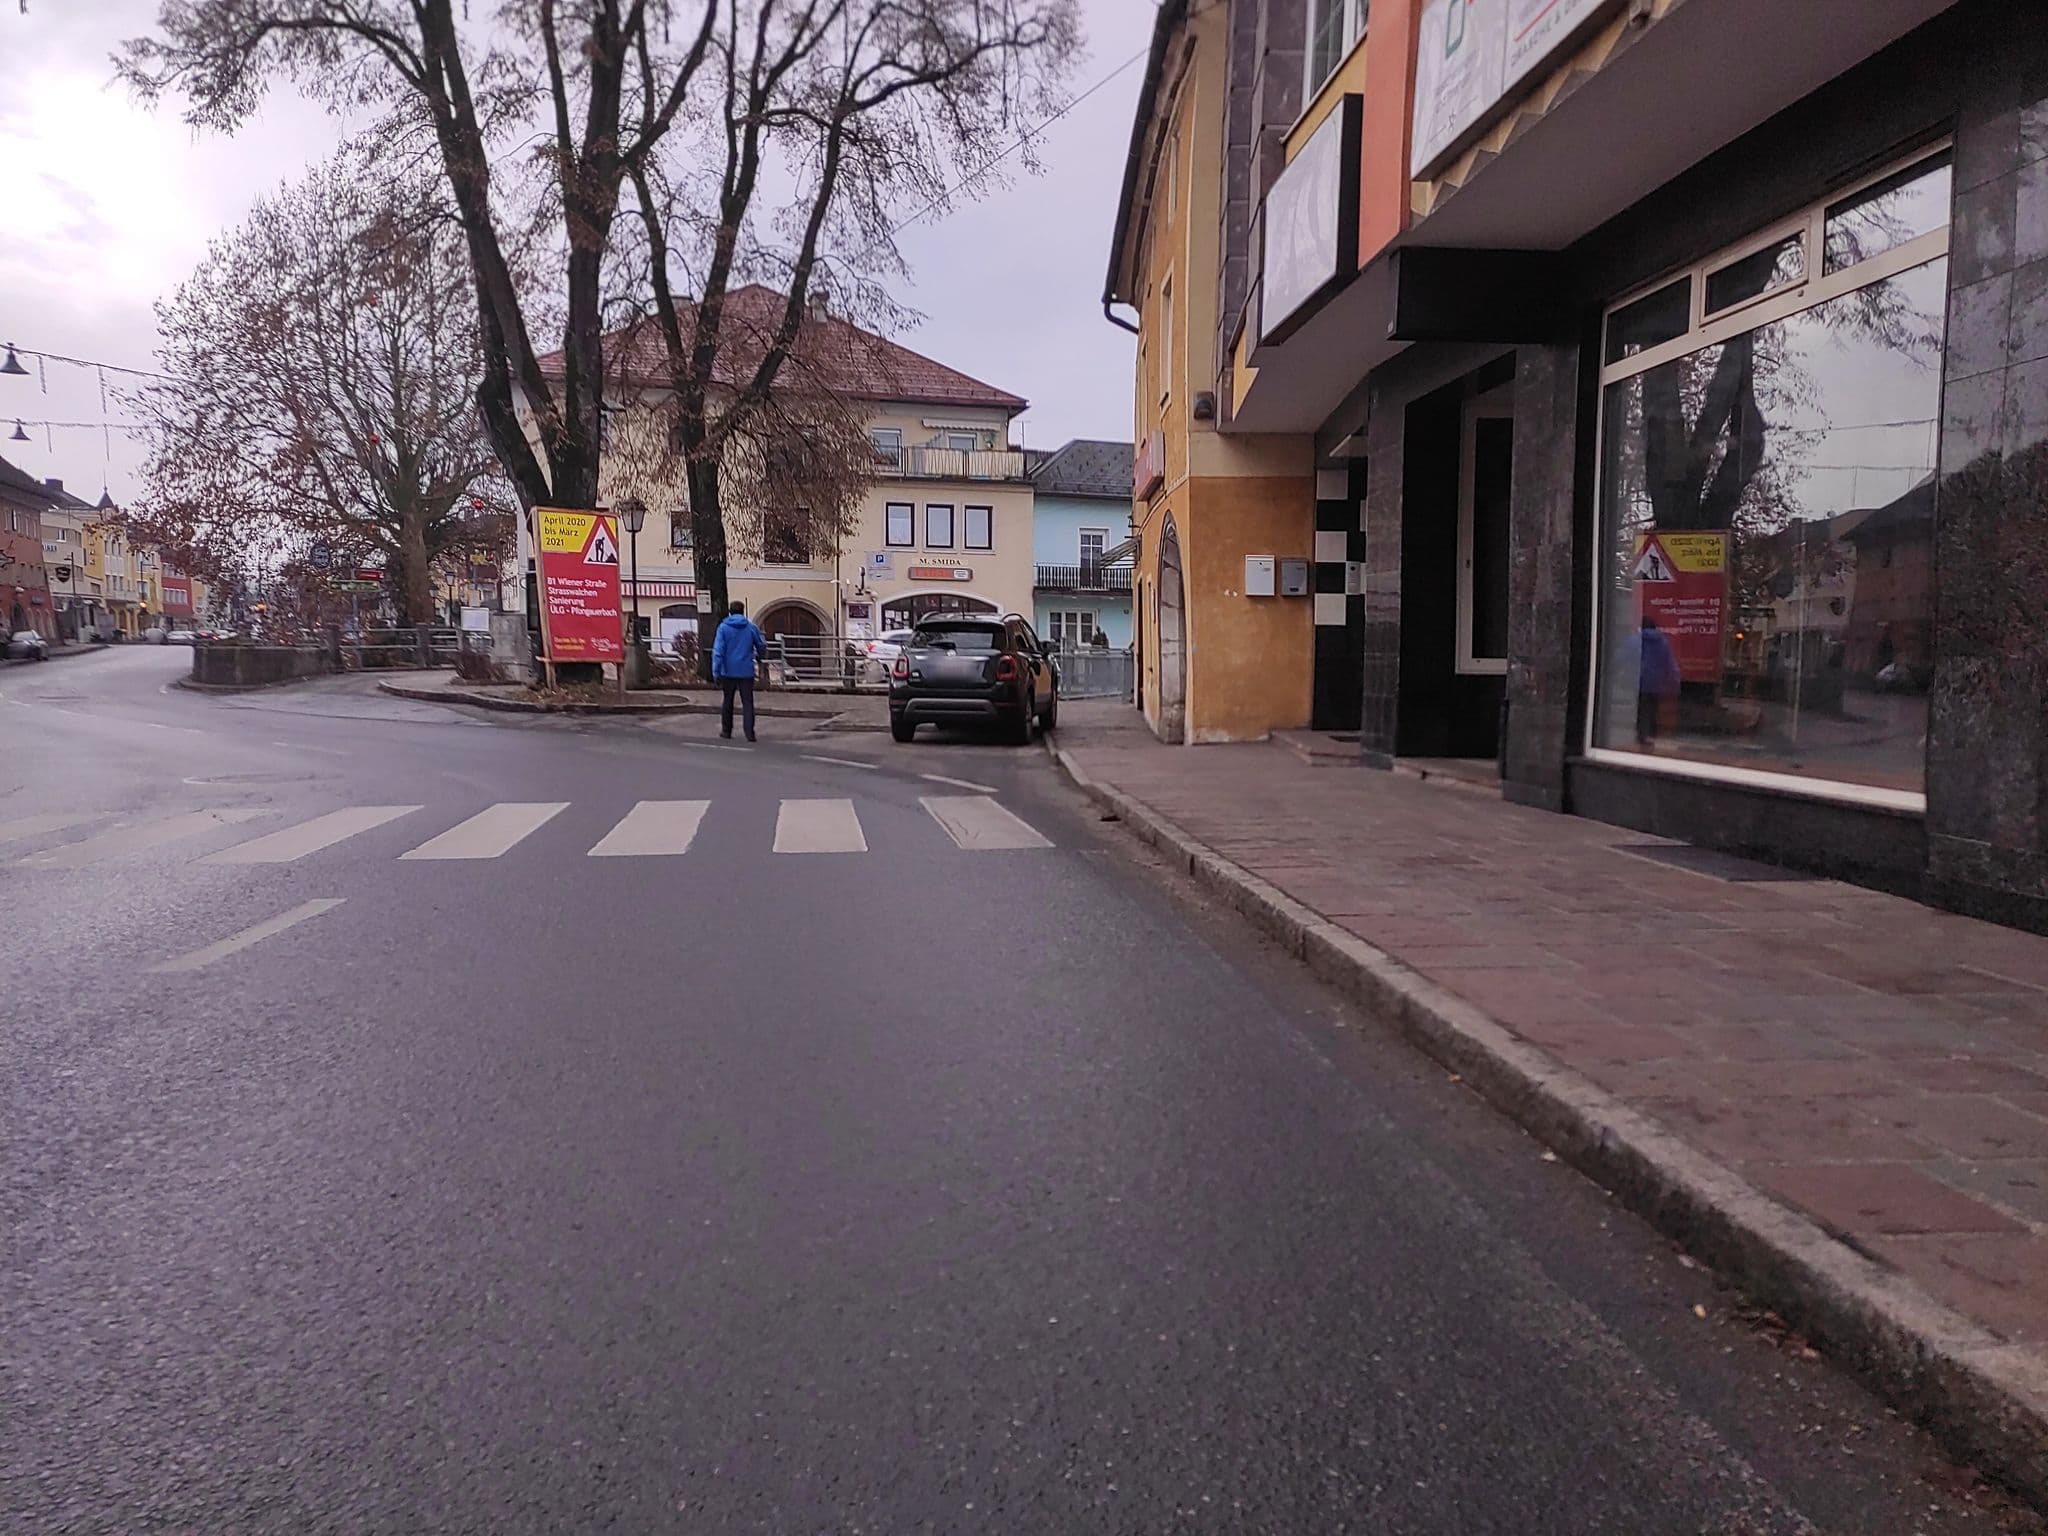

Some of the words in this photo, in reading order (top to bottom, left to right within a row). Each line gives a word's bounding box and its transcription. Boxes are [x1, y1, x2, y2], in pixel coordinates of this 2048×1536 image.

[544, 515, 564, 525] April
[567, 518, 586, 526] 2020
[544, 527, 556, 535] bis
[559, 528, 579, 536] März
[546, 537, 564, 546] 2021
[557, 577, 584, 586] Wiener
[549, 596, 585, 607] Sanierung
